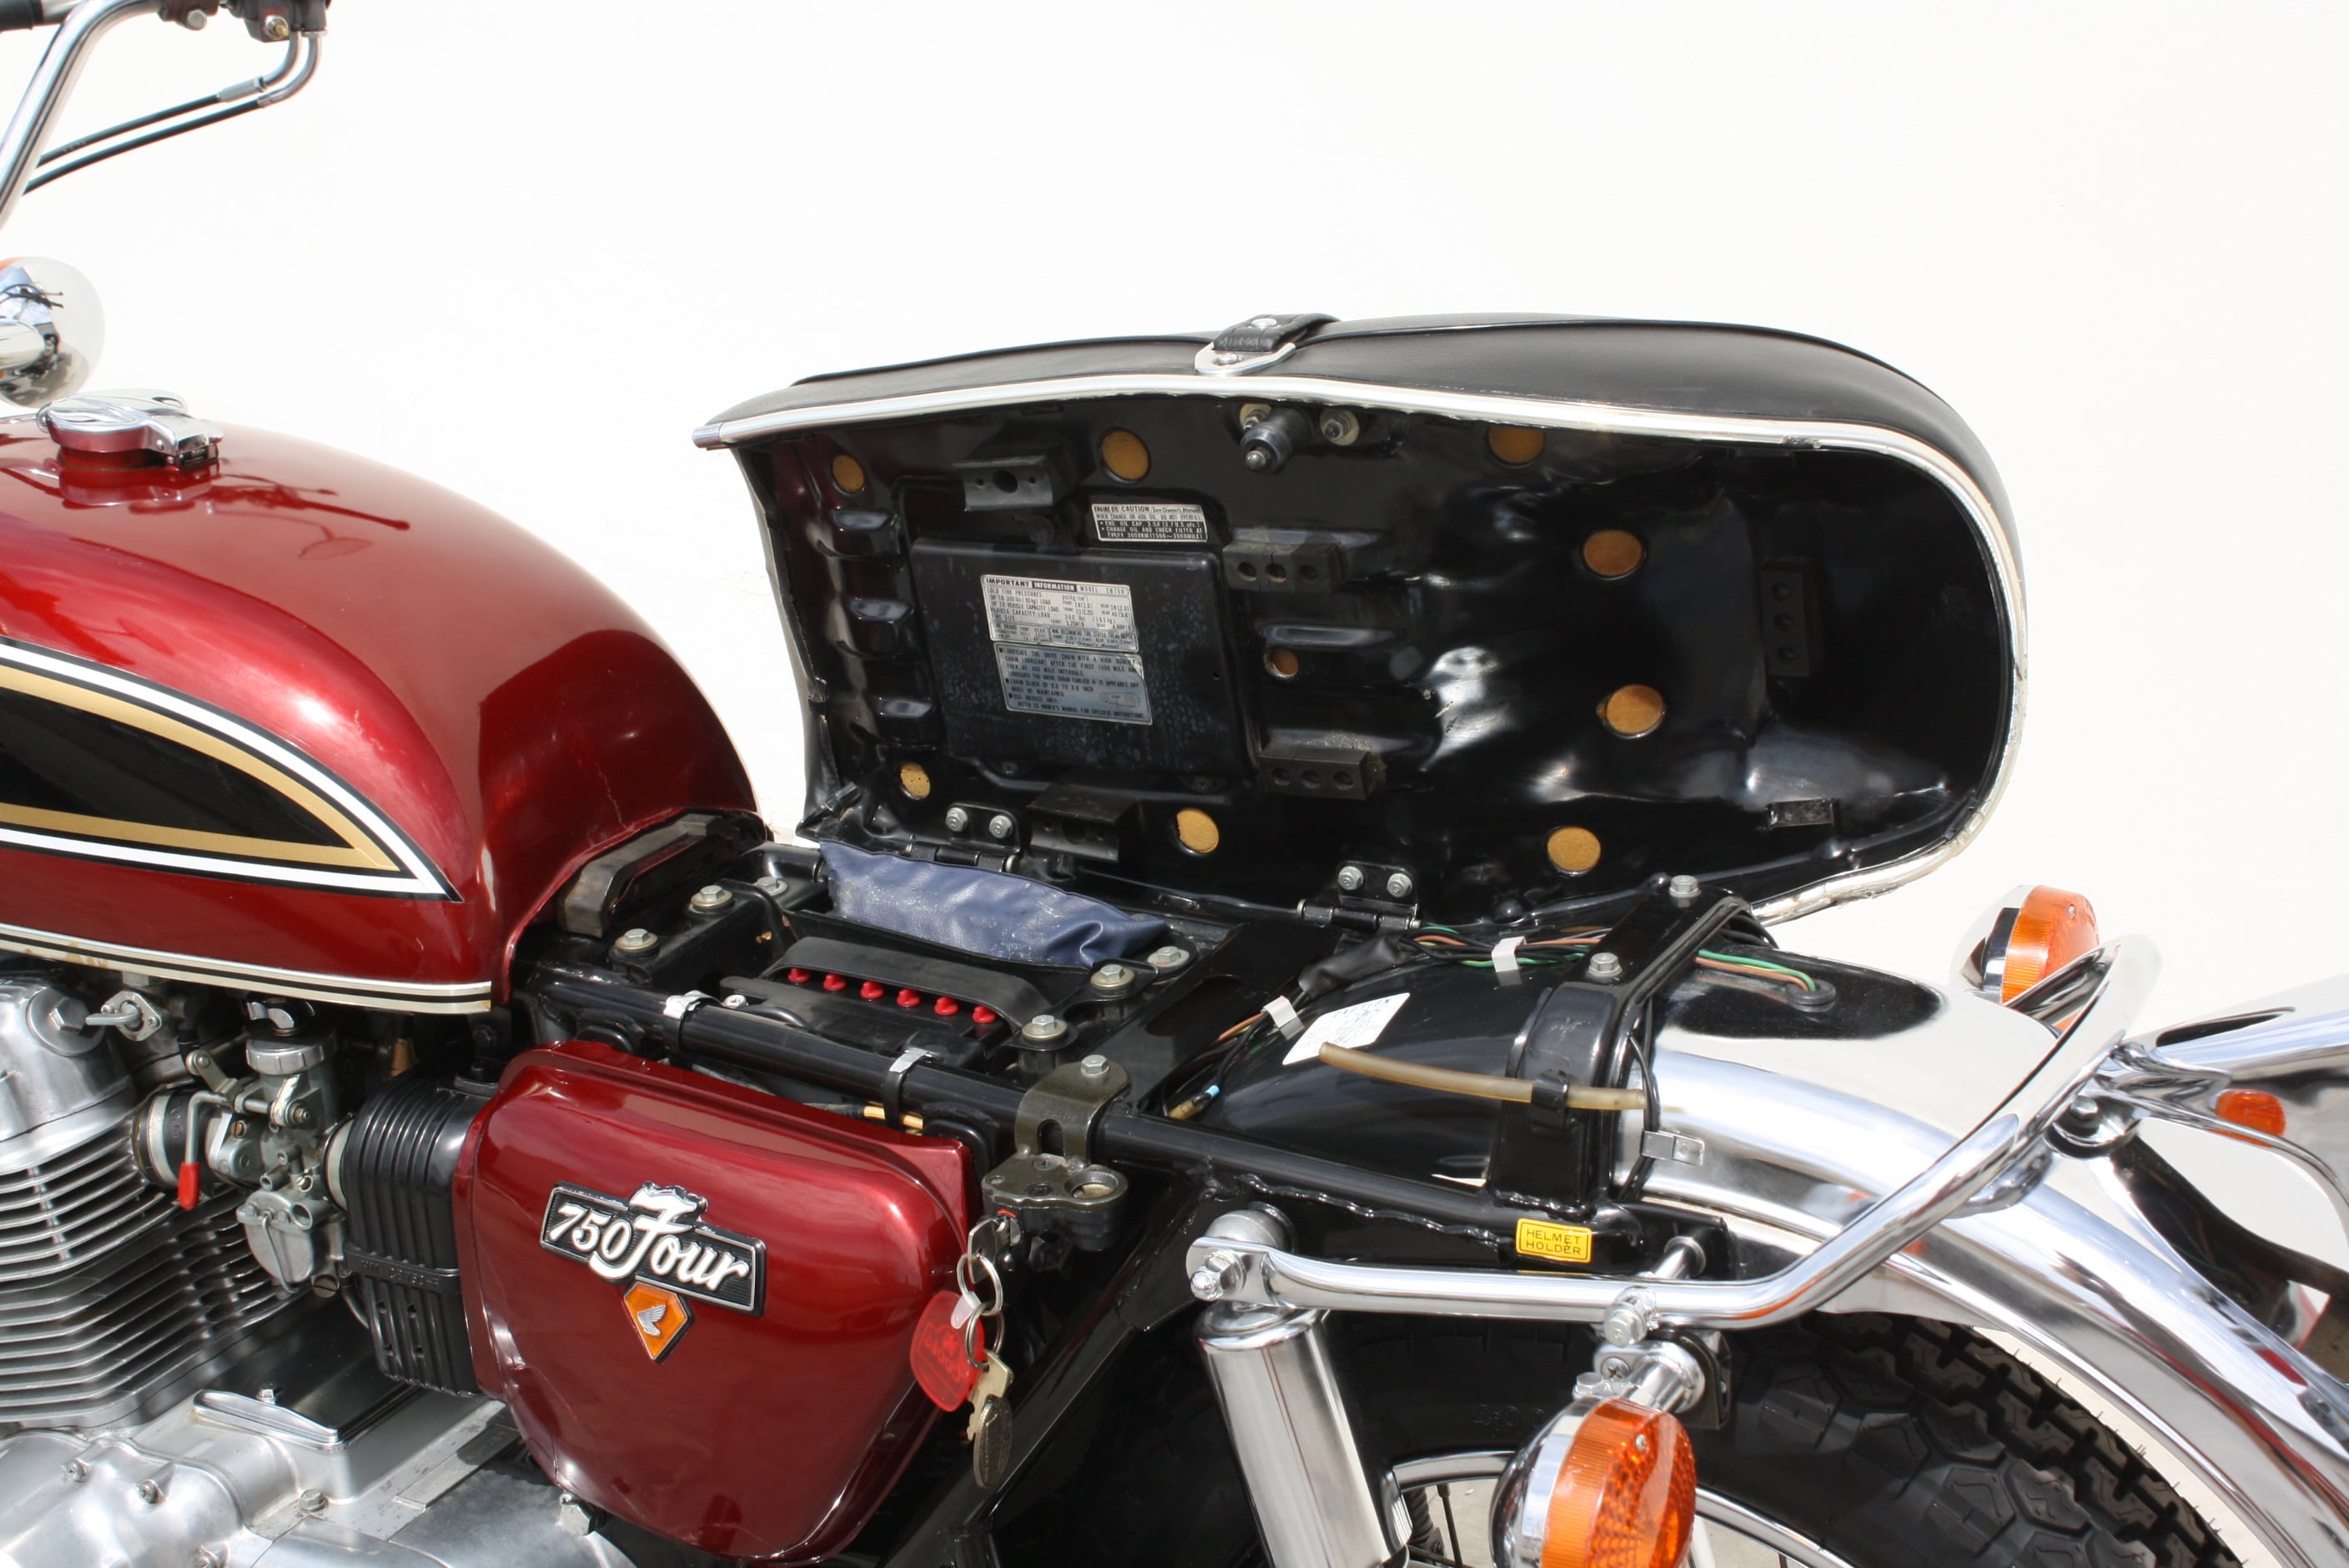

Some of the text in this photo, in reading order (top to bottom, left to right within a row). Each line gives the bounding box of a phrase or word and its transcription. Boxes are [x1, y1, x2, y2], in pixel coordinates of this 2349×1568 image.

[985, 578, 1029, 586] IMPORTANT
[1034, 581, 1074, 591] INFORMATION
[549, 1186, 751, 1291] 750 Four
[1527, 1229, 1582, 1244] HELMET
[1526, 1240, 1582, 1255] HOLDER
